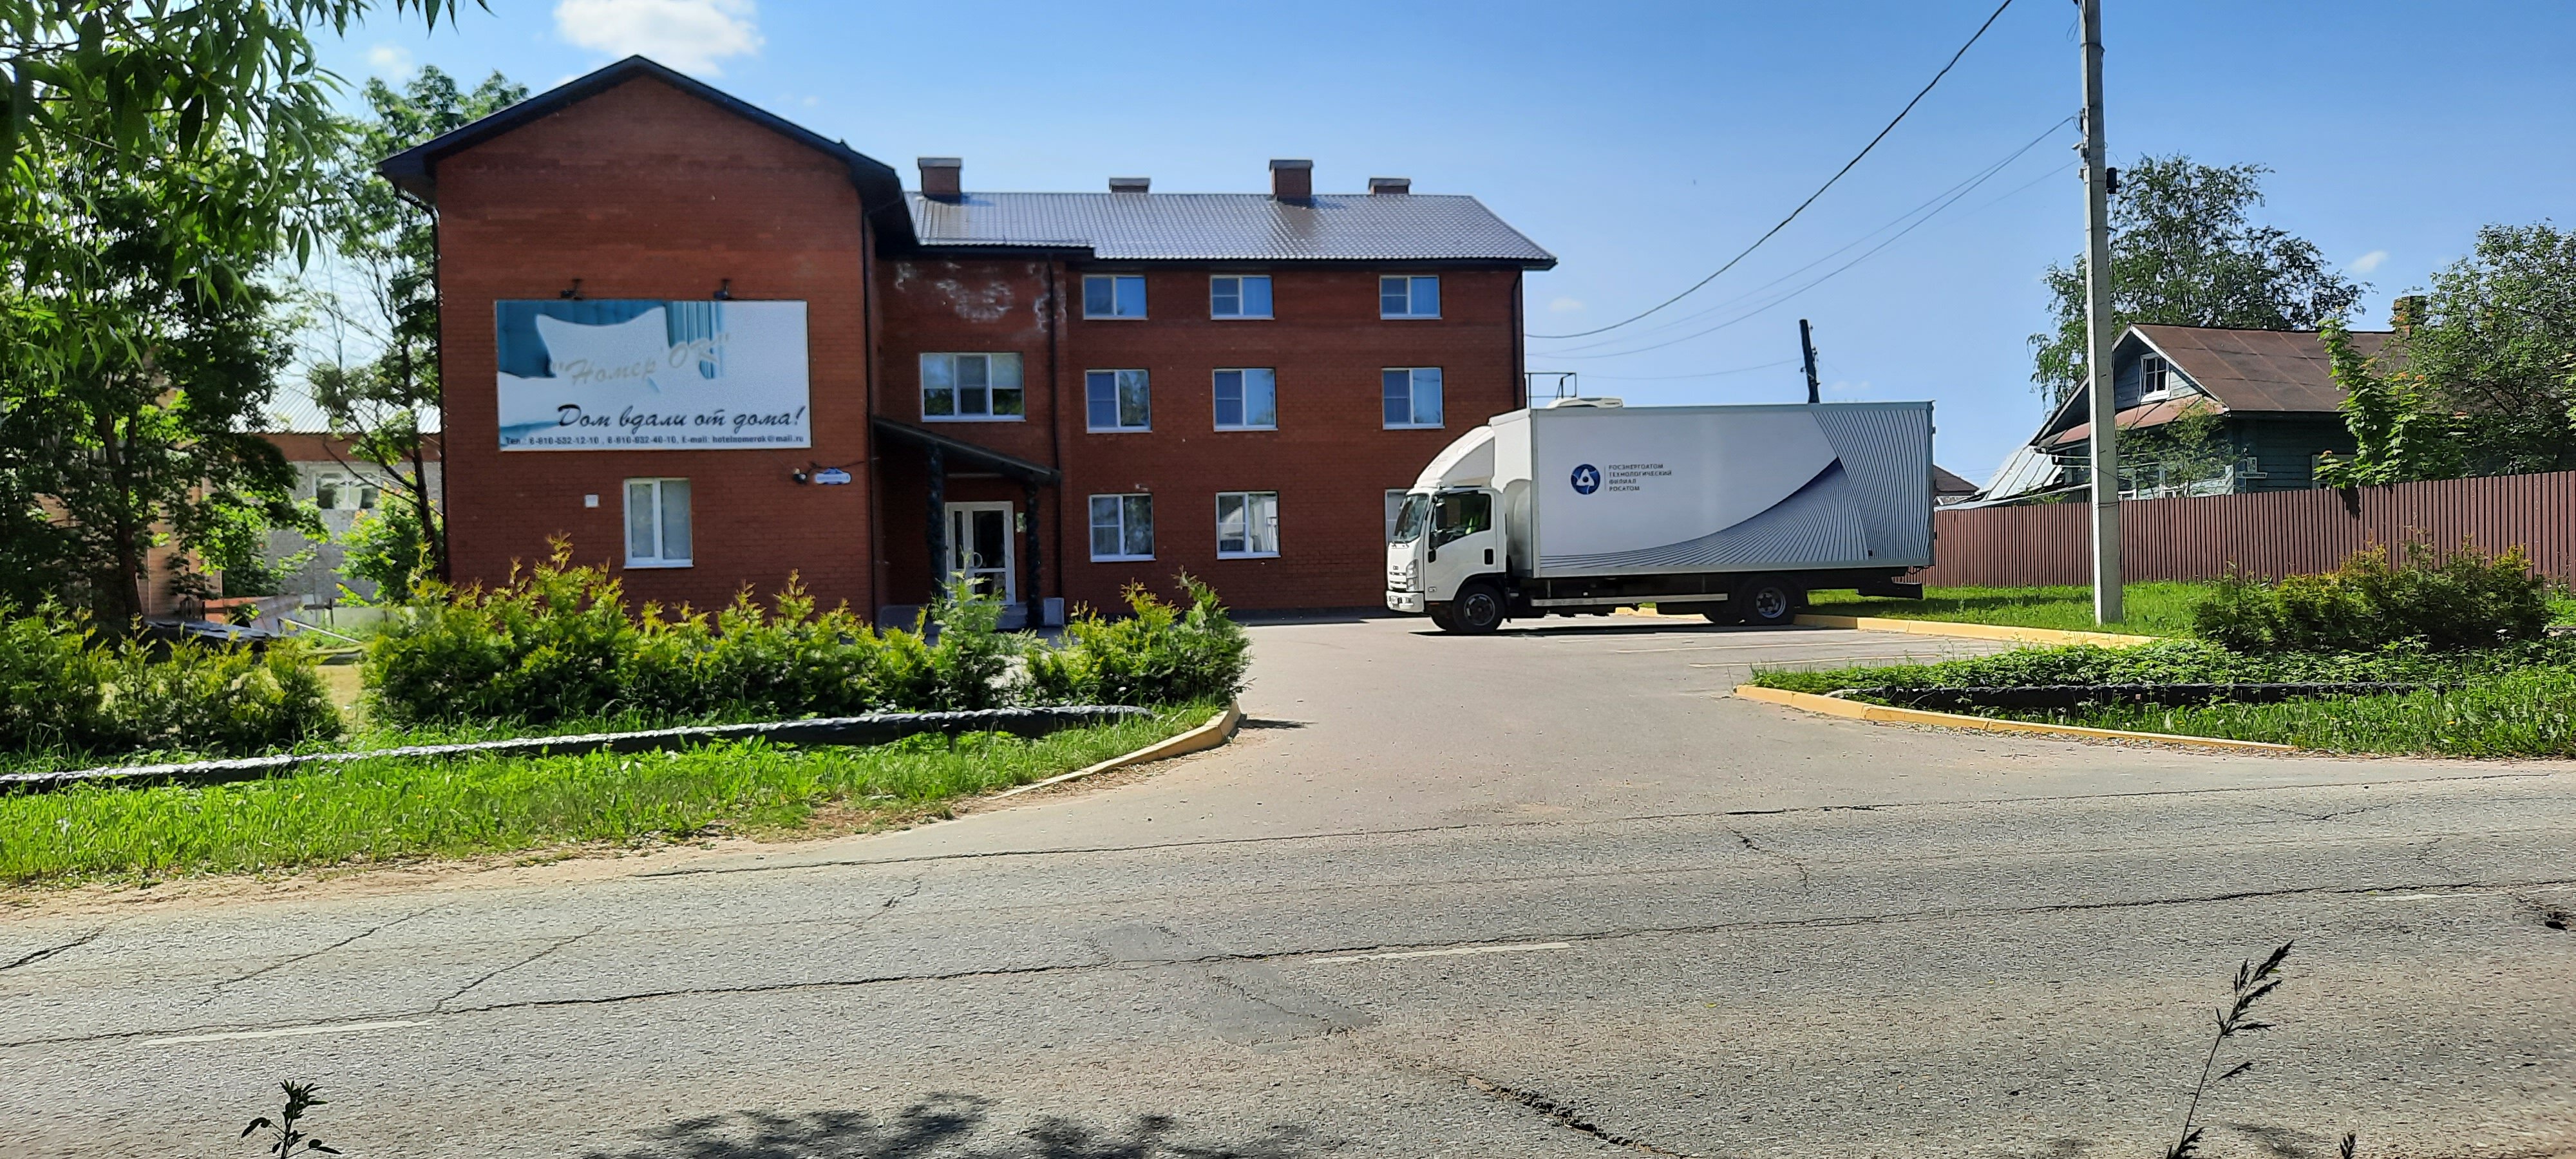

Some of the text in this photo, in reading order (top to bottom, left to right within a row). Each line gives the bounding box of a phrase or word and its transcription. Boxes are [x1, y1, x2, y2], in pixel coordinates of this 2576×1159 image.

[556, 403, 806, 435] Дом вдали от дома!
